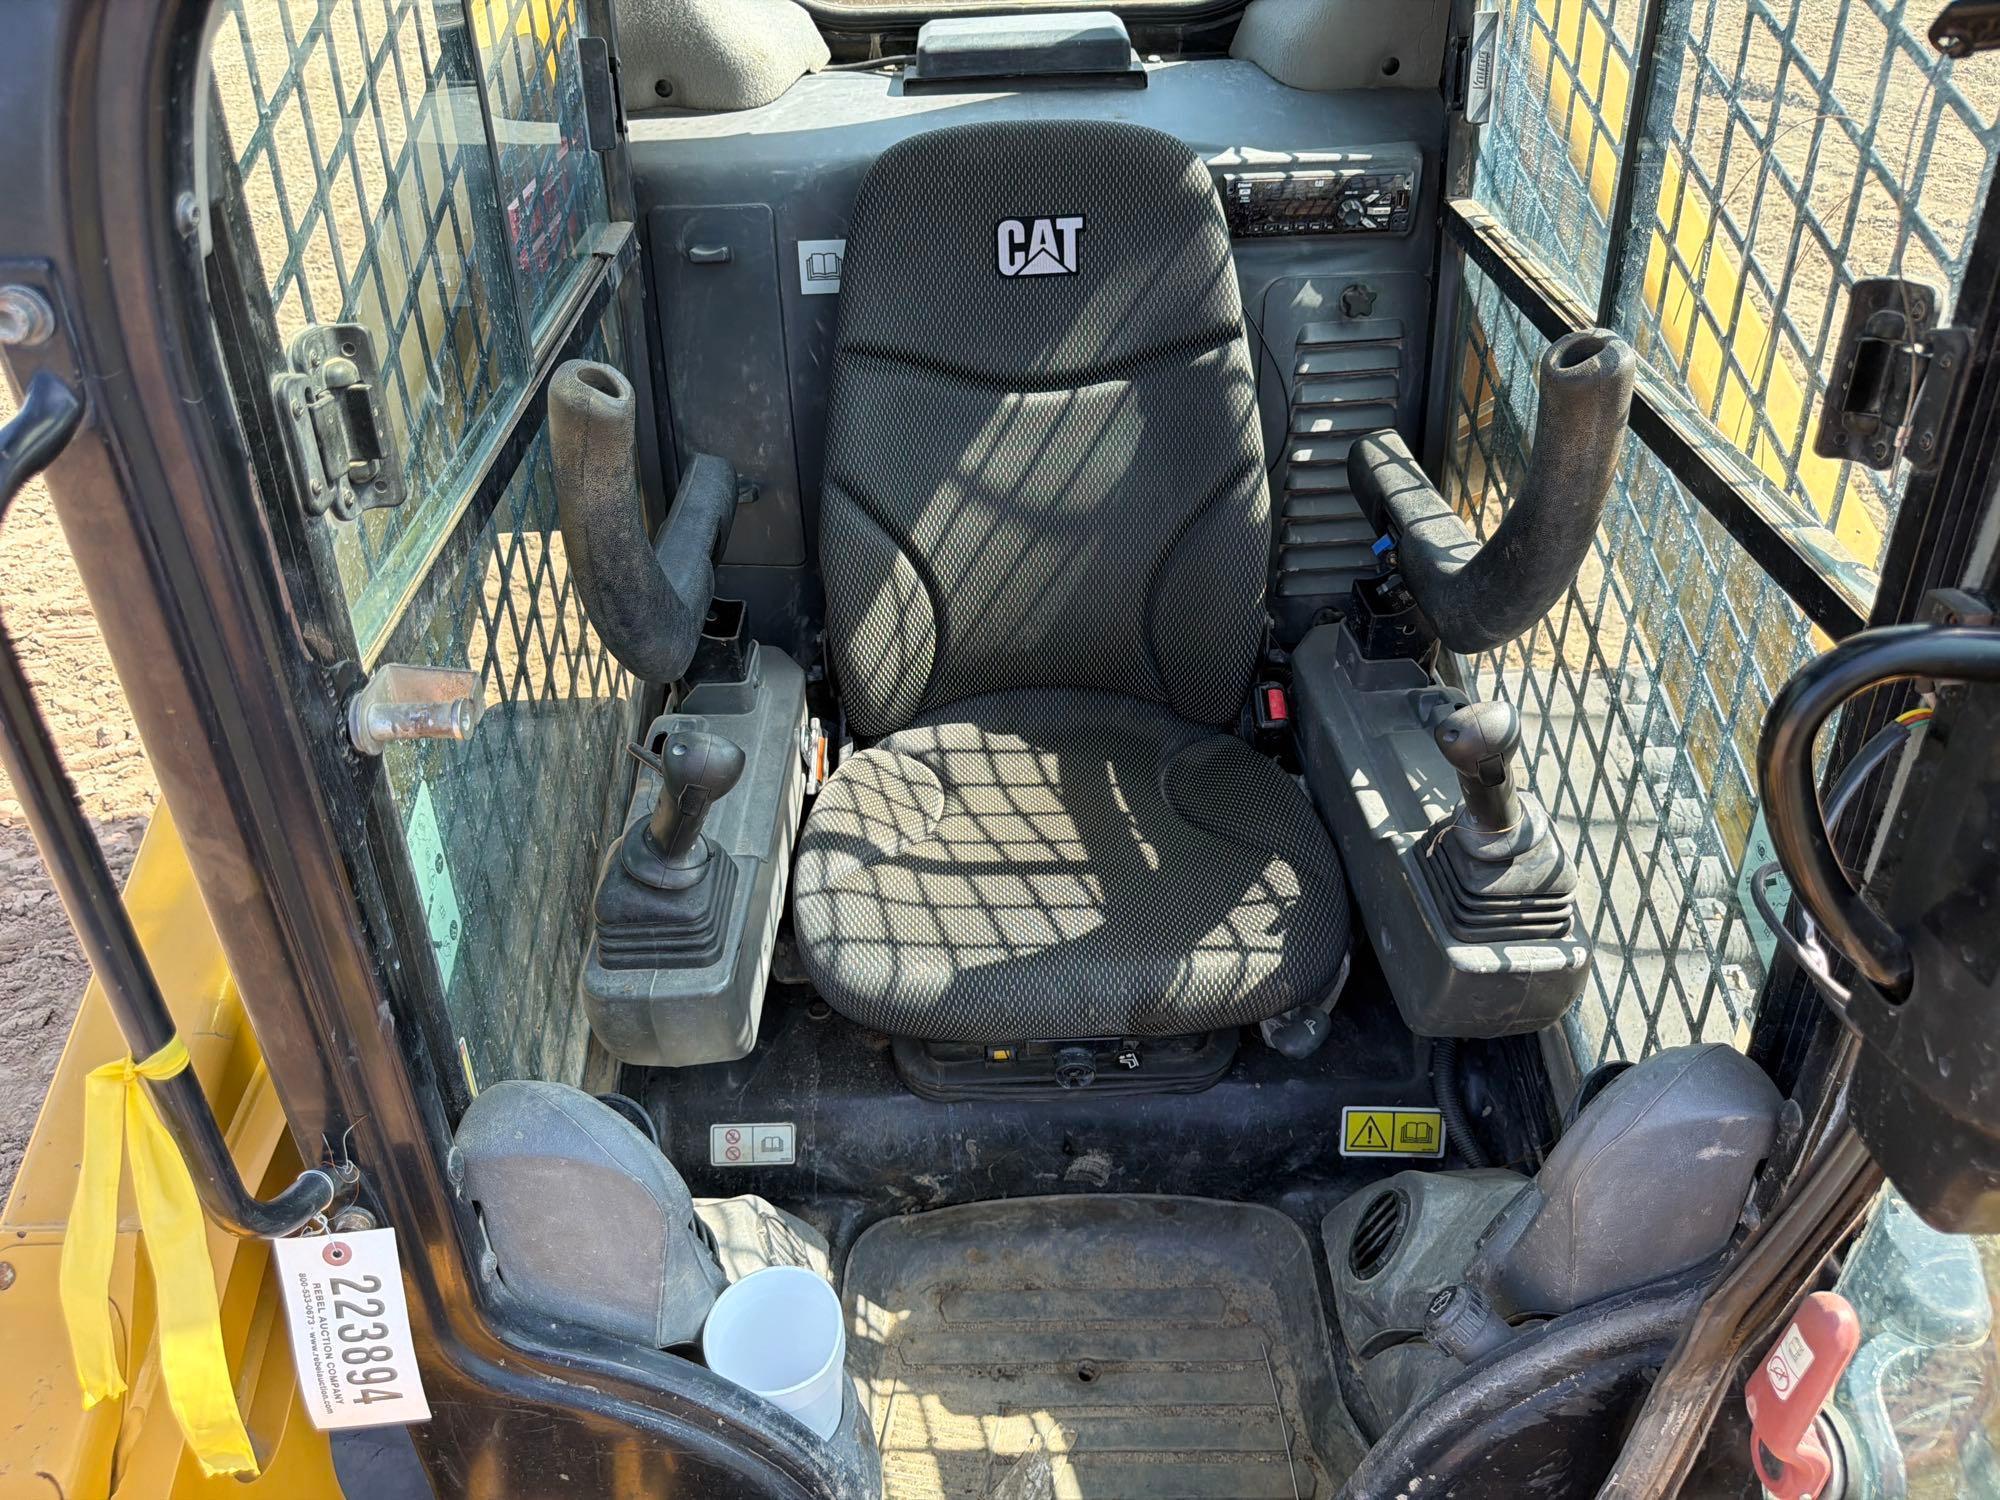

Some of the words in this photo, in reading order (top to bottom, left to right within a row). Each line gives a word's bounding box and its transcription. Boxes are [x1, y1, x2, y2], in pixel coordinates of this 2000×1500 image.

[997, 216, 1083, 276] CAT
[312, 1283, 326, 1314] REBEL
[298, 1272, 316, 1326] 800-533-0673
[309, 1331, 334, 1415] www.rebelauction.com
[318, 1316, 333, 1360] AUCTION
[329, 1274, 403, 1405] 223894
[326, 1362, 345, 1405] COMPANY
